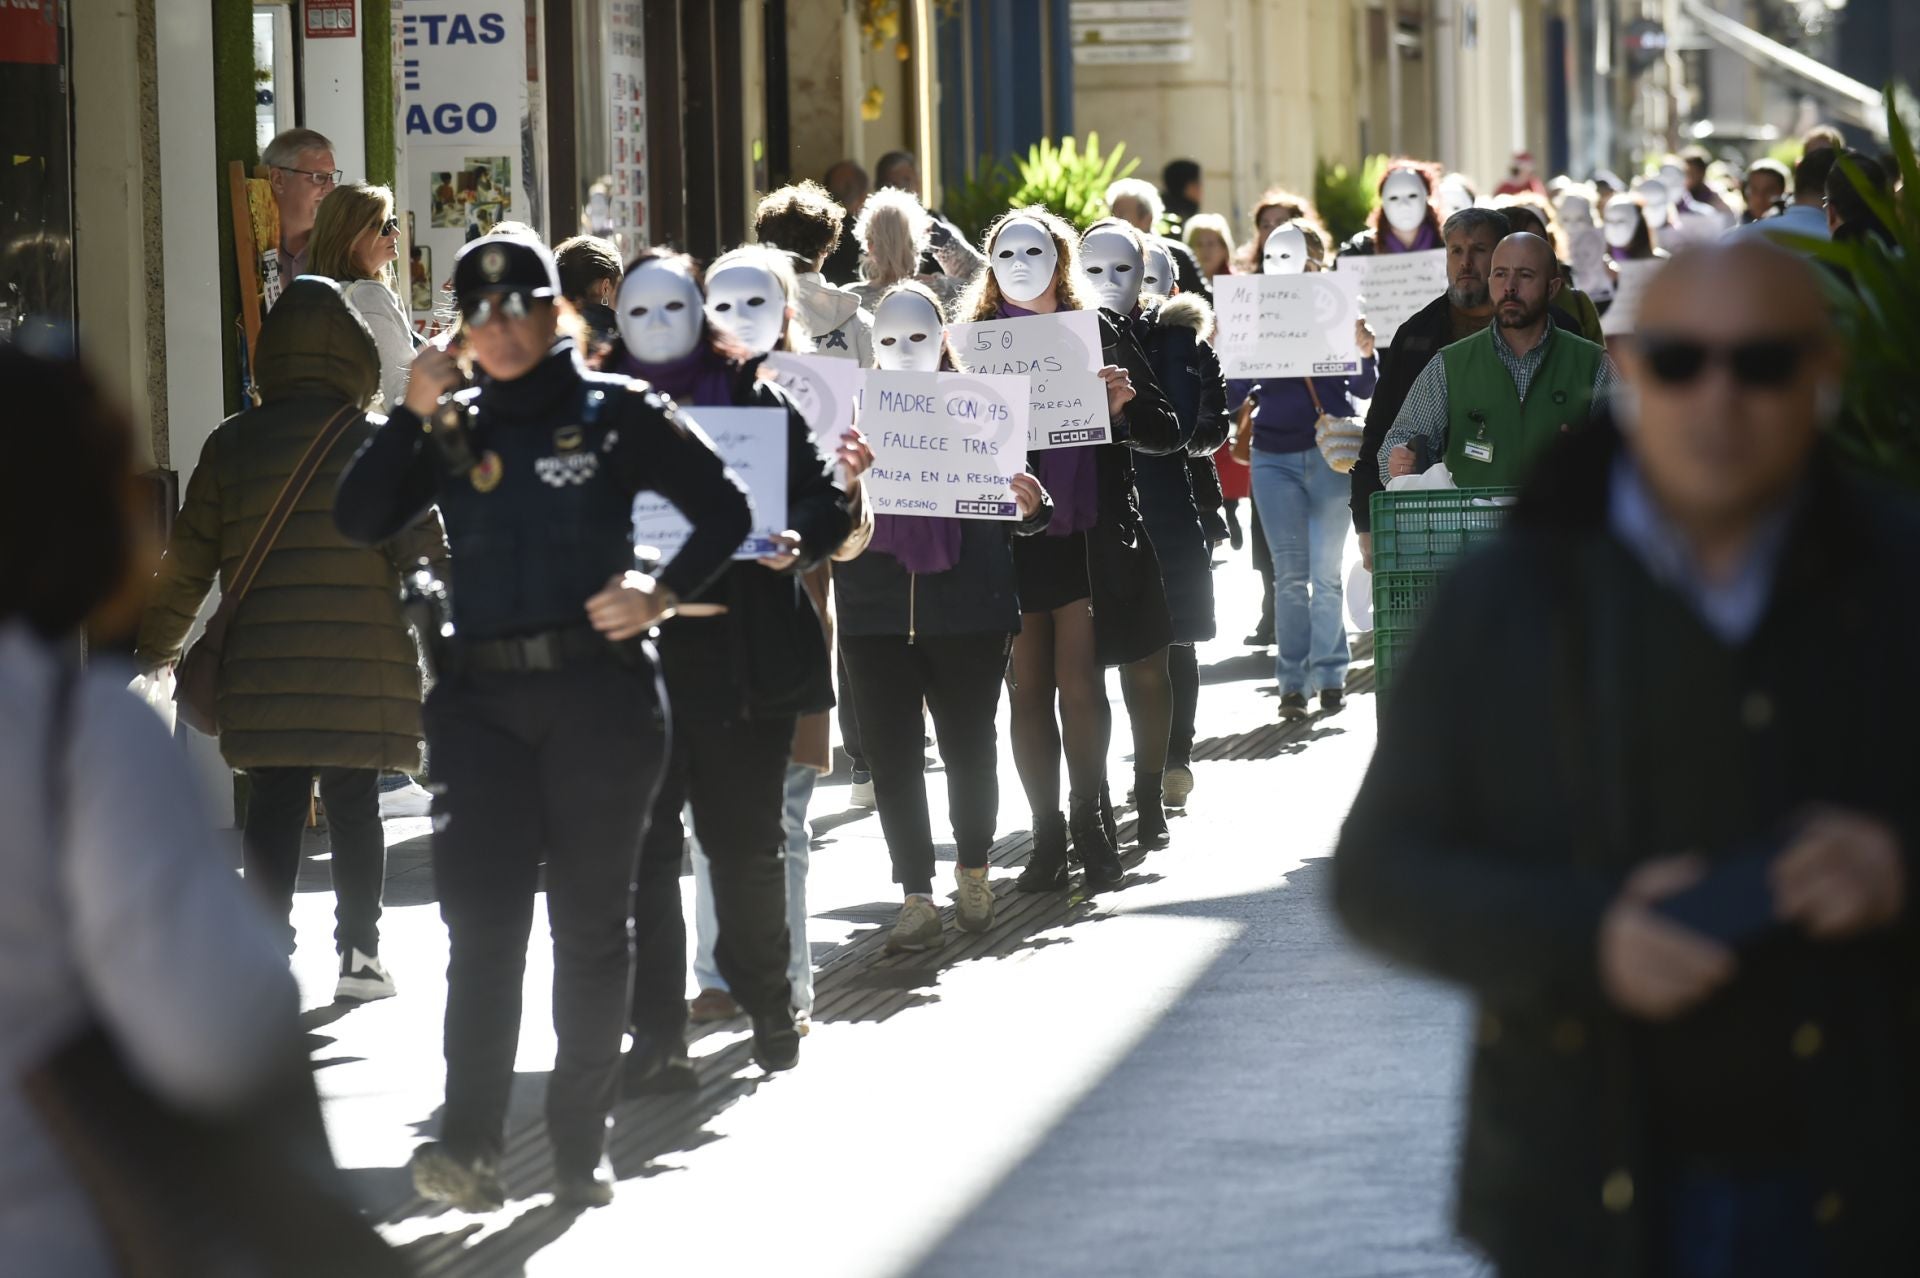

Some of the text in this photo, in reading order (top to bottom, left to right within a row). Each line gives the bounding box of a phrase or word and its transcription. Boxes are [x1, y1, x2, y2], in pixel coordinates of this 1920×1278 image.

[406, 102, 497, 135] AGO
[974, 330, 1013, 351] 50
[879, 390, 937, 414] MADRE
[946, 397, 979, 419] CON
[988, 403, 1009, 421] 95
[1030, 398, 1083, 411] PAREJA
[1051, 430, 1089, 442] CCOO
[883, 431, 950, 451] FALLECE
[962, 438, 999, 456] TRAS
[921, 471, 939, 482] EN
[946, 473, 960, 483] LA
[878, 497, 891, 507] SU
[957, 501, 999, 514] CCOO
